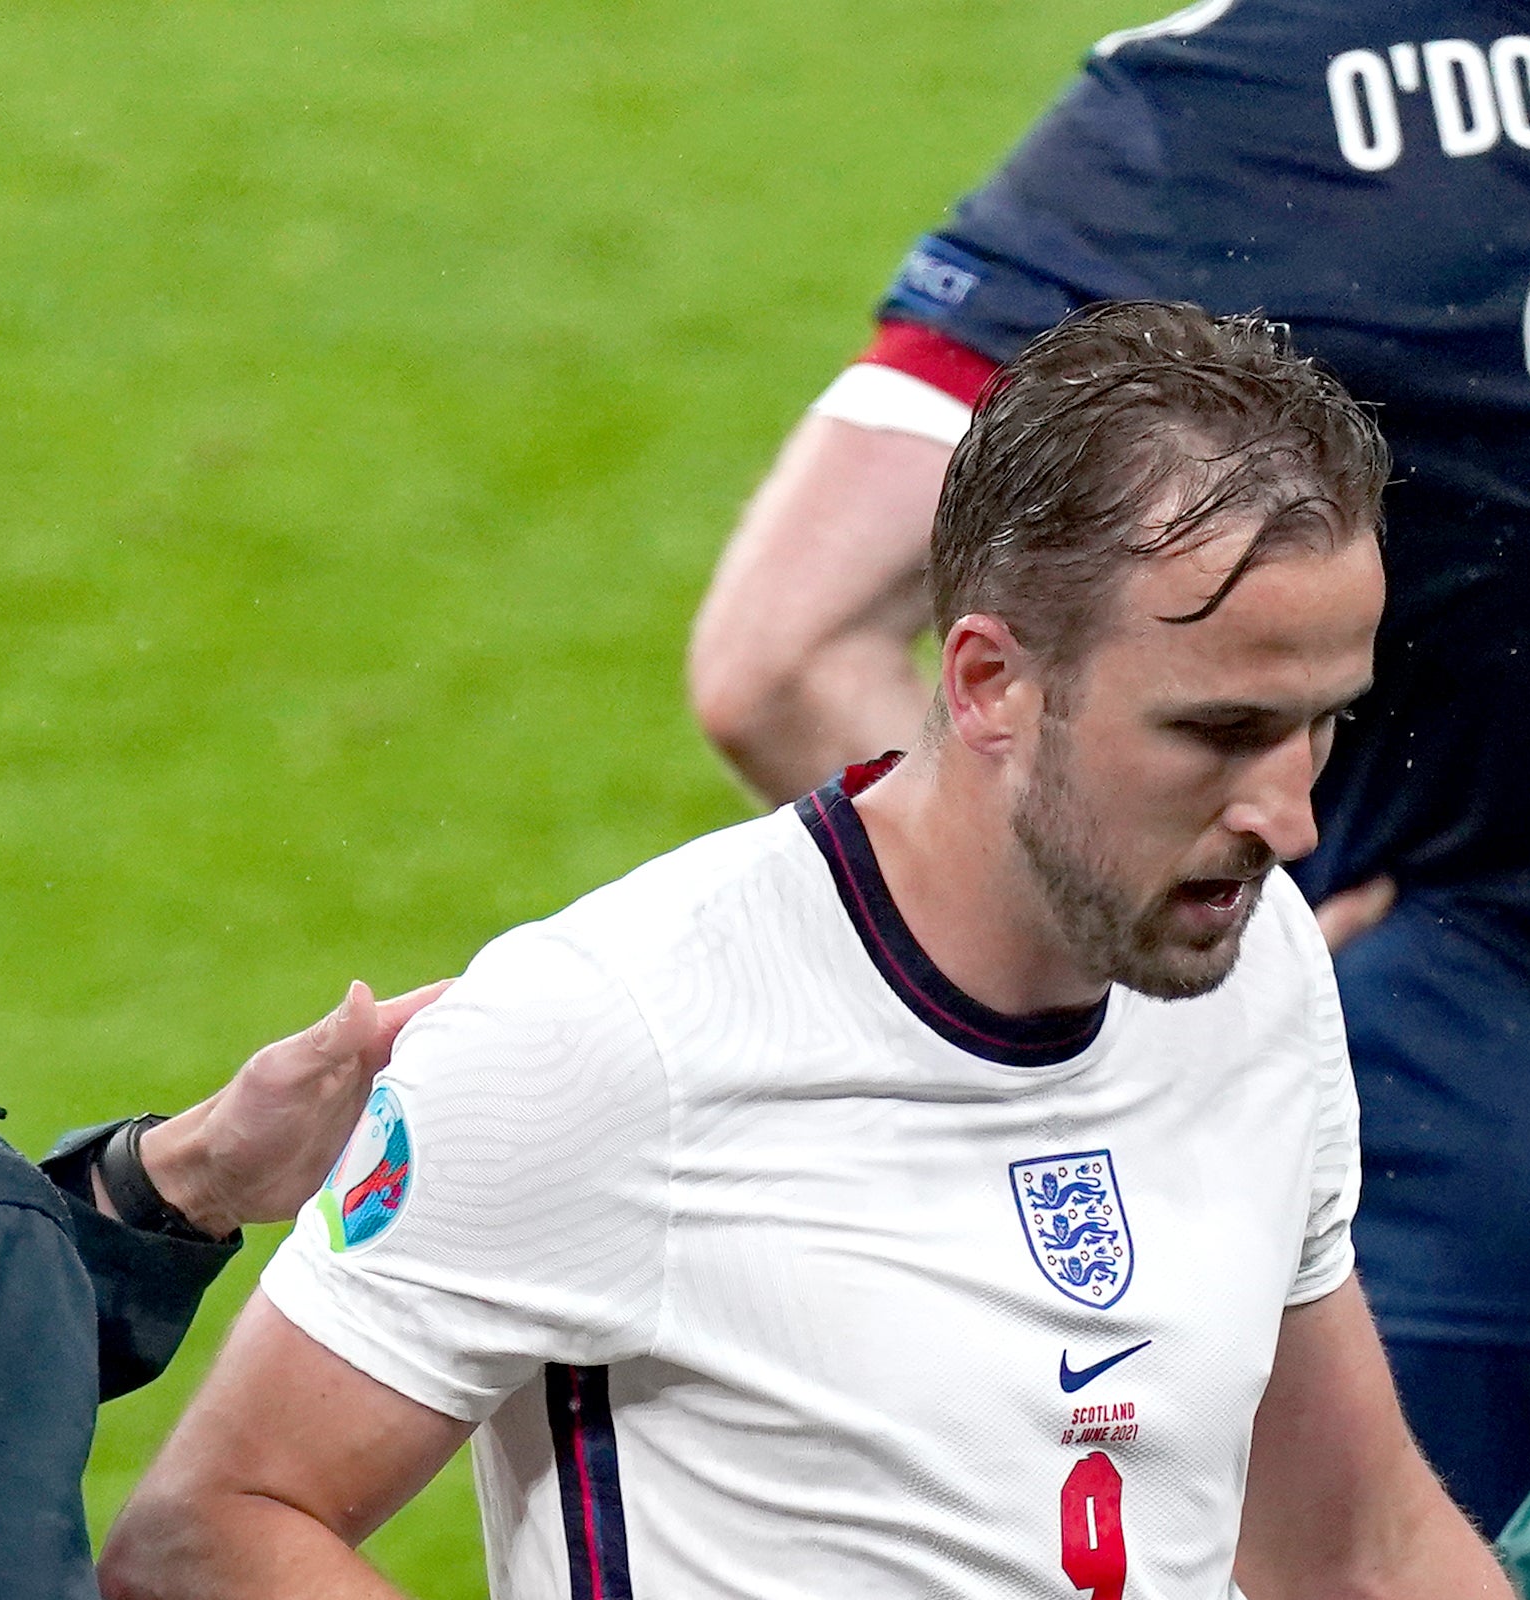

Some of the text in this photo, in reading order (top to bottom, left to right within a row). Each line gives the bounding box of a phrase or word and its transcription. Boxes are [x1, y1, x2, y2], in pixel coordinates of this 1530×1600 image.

[1071, 1402, 1135, 1425] SCOTLAND
[1076, 1426, 1111, 1443] JUNE
[1111, 1424, 1138, 1441] 2021
